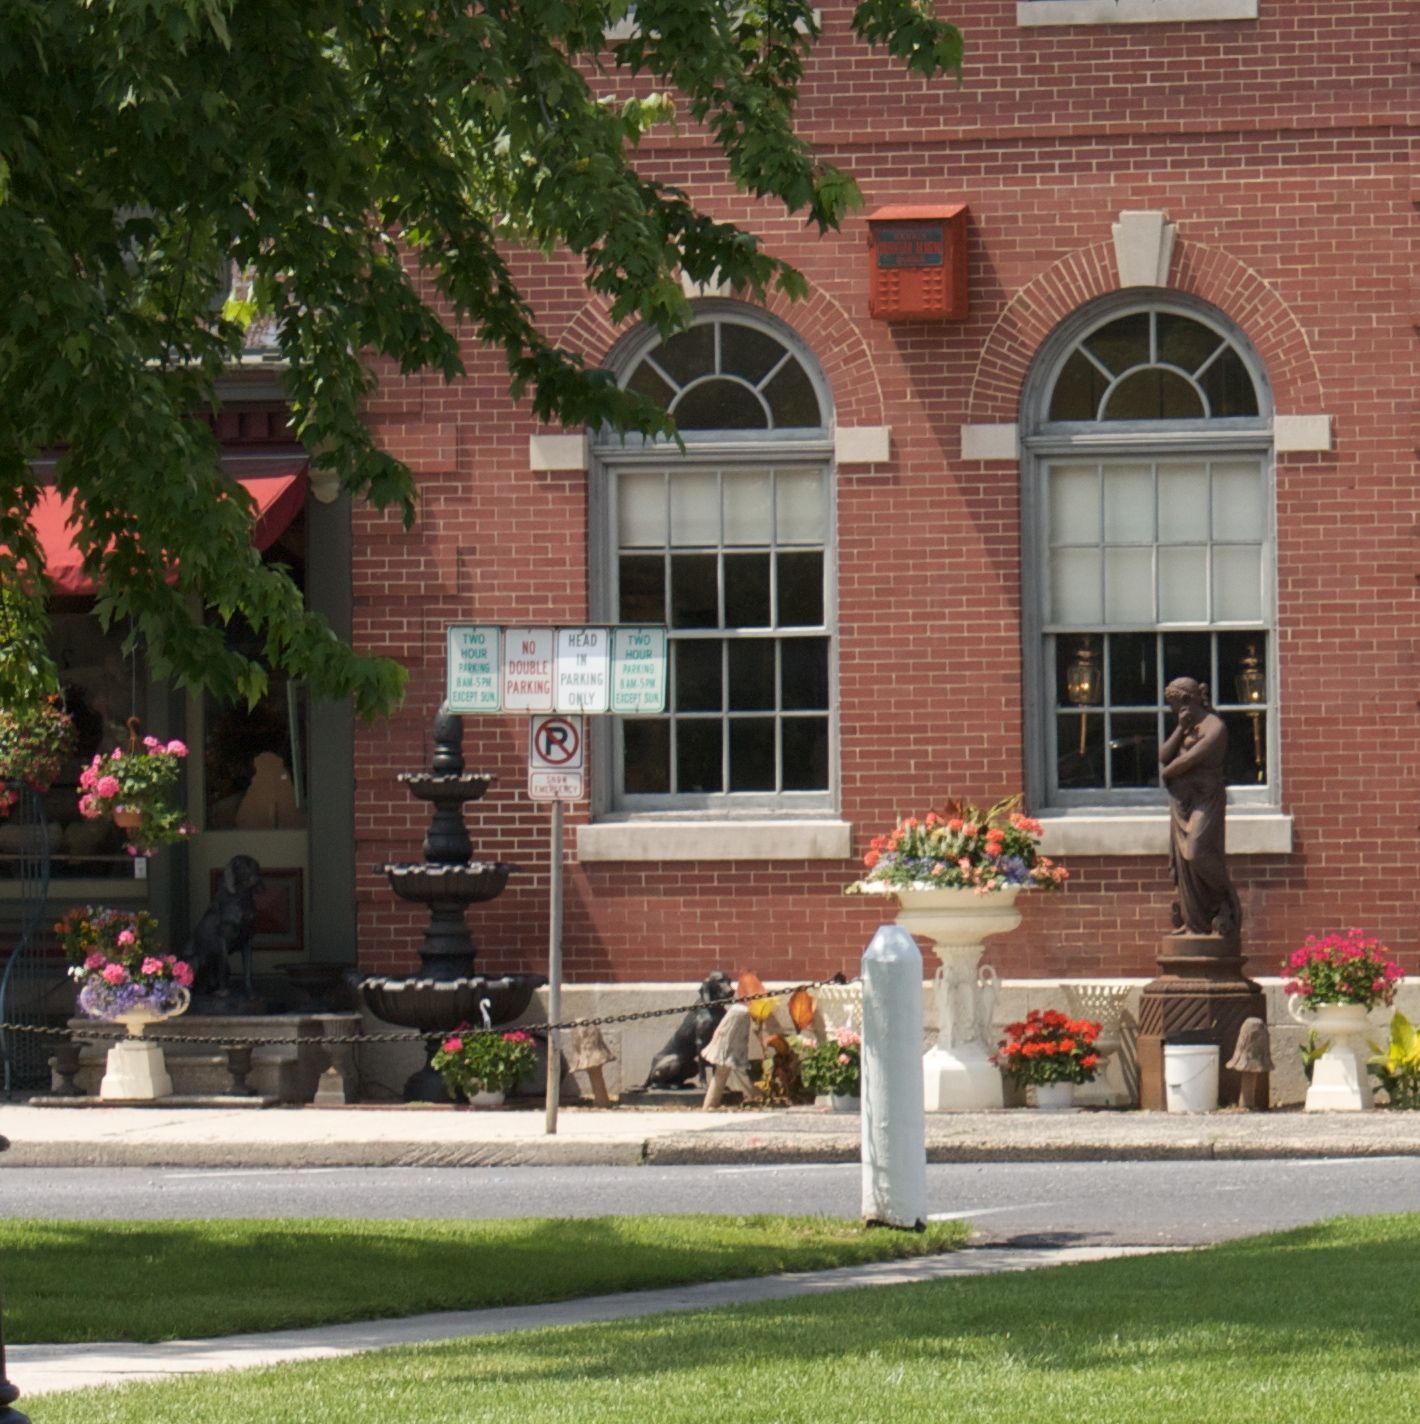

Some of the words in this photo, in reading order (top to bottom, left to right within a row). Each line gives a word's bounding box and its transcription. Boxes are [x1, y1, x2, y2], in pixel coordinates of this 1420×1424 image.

[463, 633, 485, 645] TWO
[568, 634, 597, 647] HEAD
[628, 634, 651, 645] TWO
[461, 648, 487, 659] HOUR
[522, 640, 536, 655] NO
[576, 653, 587, 666] IN
[625, 649, 652, 660] HOUR
[459, 662, 490, 673] PARKING
[509, 660, 548, 675] DOUBLE
[622, 664, 655, 674] PARKING
[560, 672, 604, 686] PARKING
[507, 680, 550, 694] PARKING
[452, 691, 478, 702] EXCEPT
[568, 692, 595, 705] ONLY
[615, 693, 641, 704] EXCEPT
